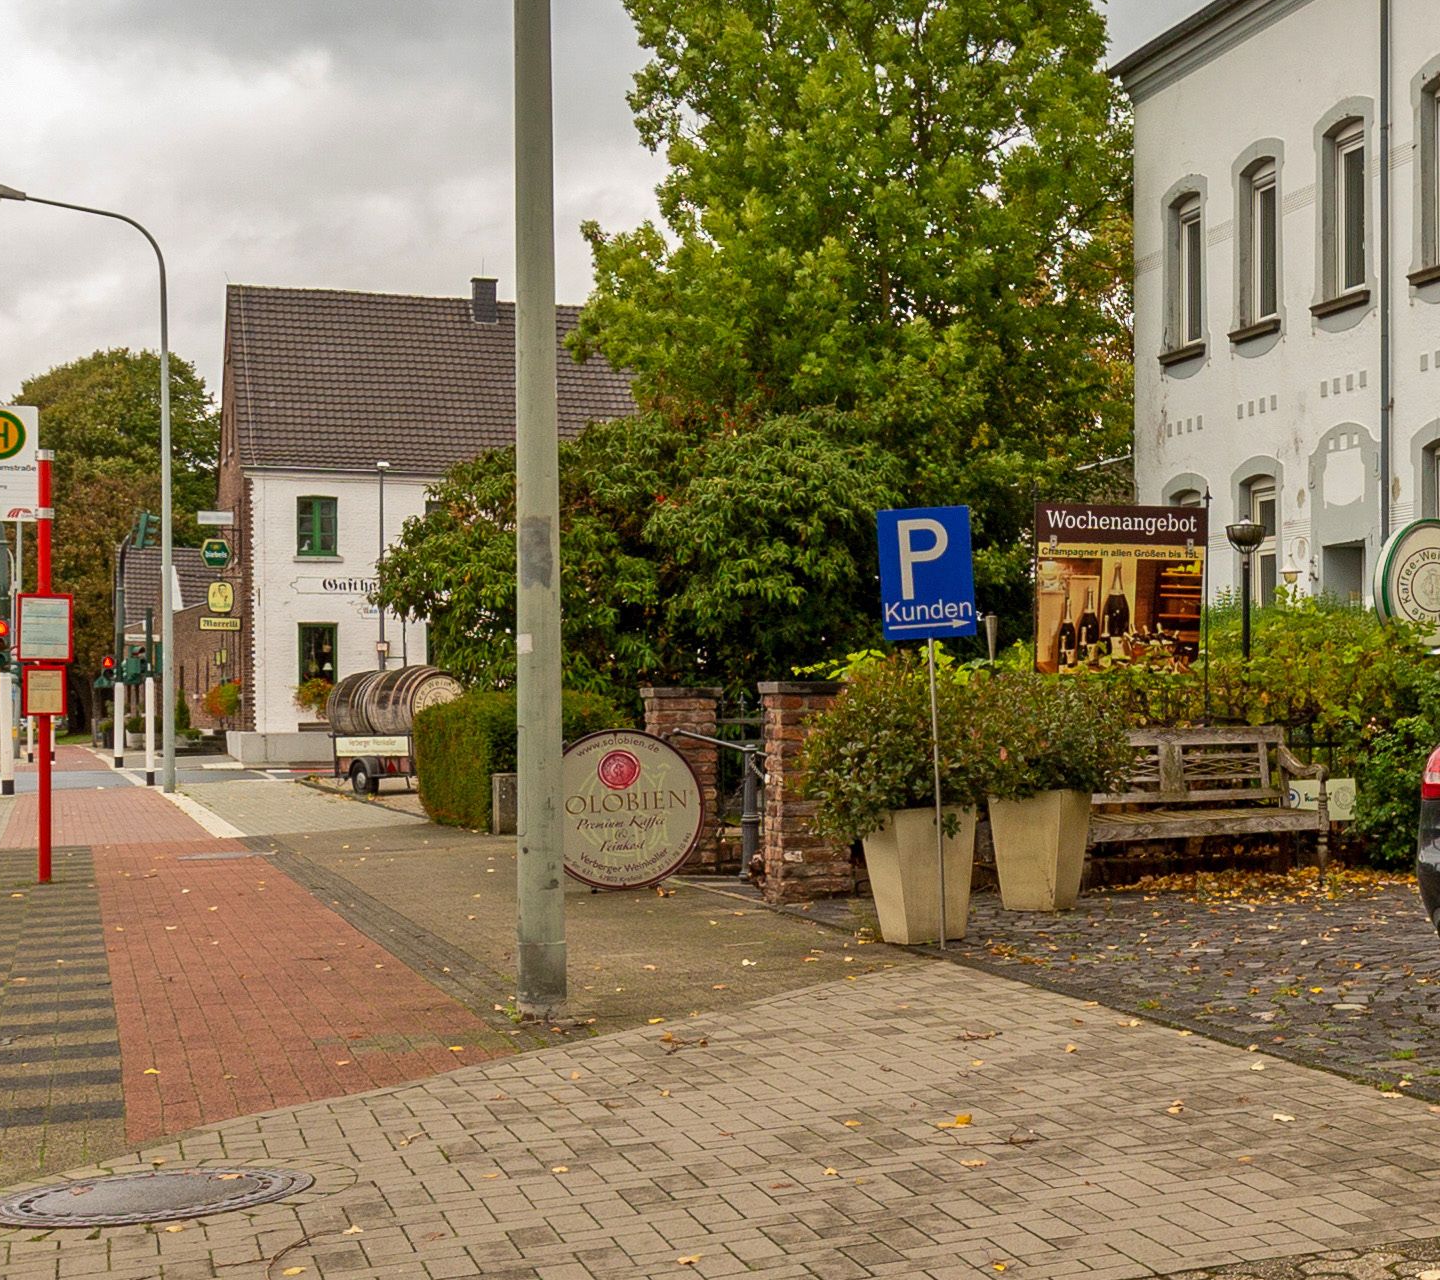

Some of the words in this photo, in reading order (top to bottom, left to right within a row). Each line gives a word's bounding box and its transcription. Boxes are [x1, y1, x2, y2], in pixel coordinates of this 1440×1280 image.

[1046, 509, 1197, 536] Wochenangebot
[897, 518, 948, 600] P
[1041, 547, 1099, 558] Champagner
[1110, 549, 1134, 558] allen
[1134, 549, 1166, 558] Größen
[1168, 549, 1182, 558] bis
[322, 578, 377, 593] Gastha
[884, 598, 972, 623] Kunden
[576, 736, 660, 757] www.solobien.de
[565, 789, 688, 815] OLOBIEN
[576, 818, 624, 830] Premium
[628, 815, 666, 832] Kaffee
[600, 839, 646, 852] Feinkost
[580, 852, 623, 874] Verberger
[624, 848, 668, 873] Weinkeller
